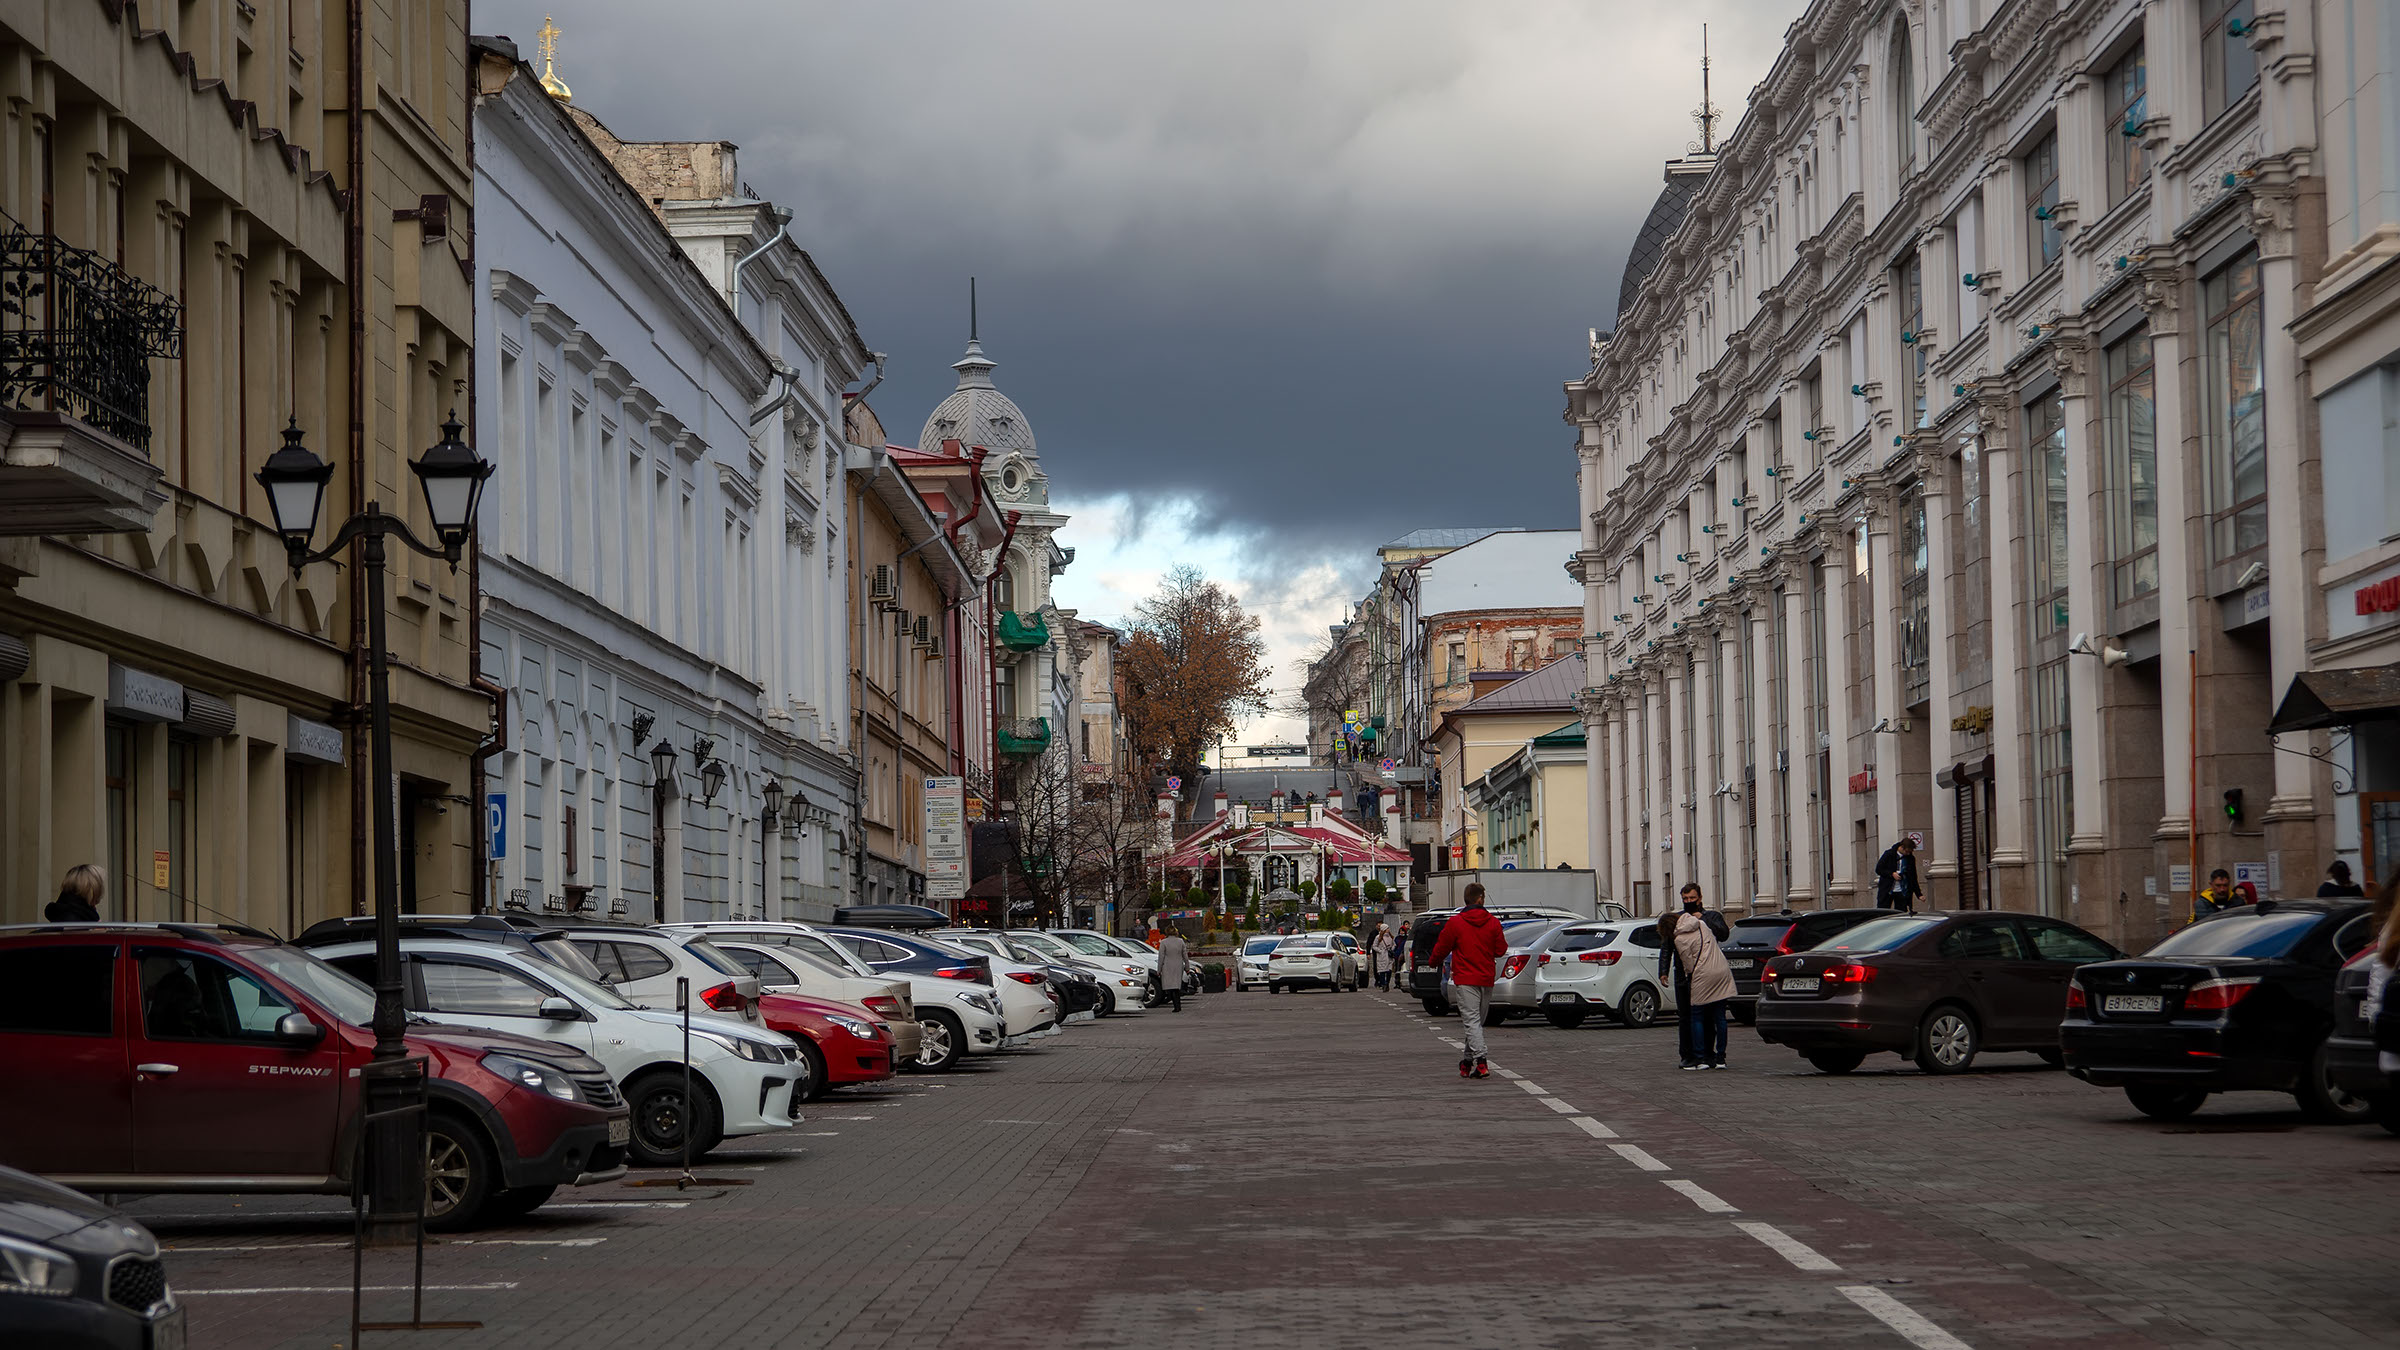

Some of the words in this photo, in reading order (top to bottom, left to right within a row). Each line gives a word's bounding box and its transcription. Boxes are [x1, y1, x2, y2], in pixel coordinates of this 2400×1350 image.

[960, 899, 990, 911] BAR
[2108, 997, 2144, 1010] Е819СЕ
[2145, 996, 2160, 1007] 716
[248, 1065, 322, 1077] STEPWAY
